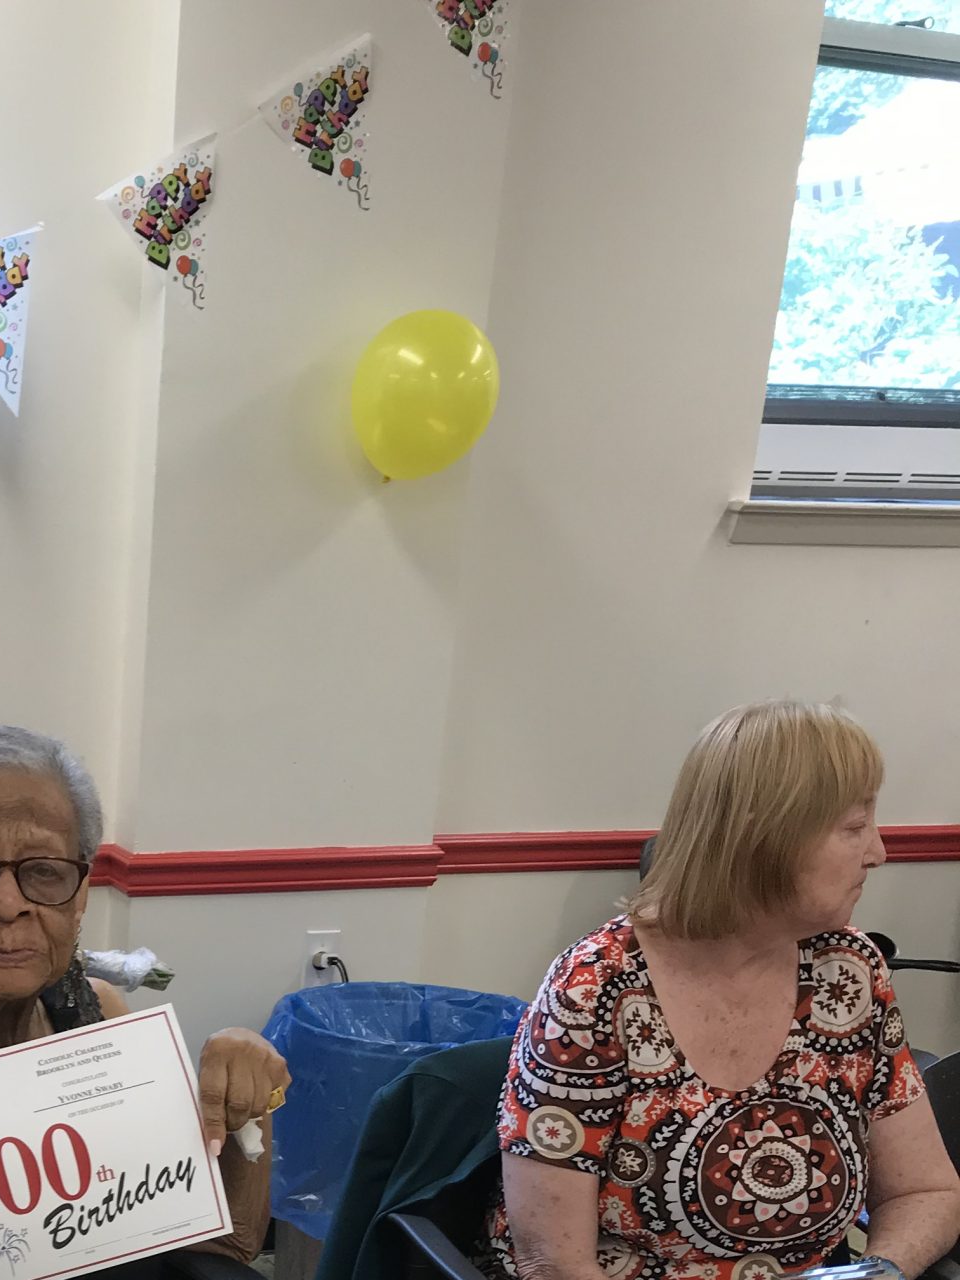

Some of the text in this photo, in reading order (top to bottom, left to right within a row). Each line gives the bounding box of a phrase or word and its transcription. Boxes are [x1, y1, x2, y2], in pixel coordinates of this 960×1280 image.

[36, 1062, 76, 1077] BROOKLYN
[92, 1050, 122, 1062] QUEENS
[37, 1042, 113, 1066] CATHOLIC CHARITIES
[43, 1156, 197, 1249] Birthday
